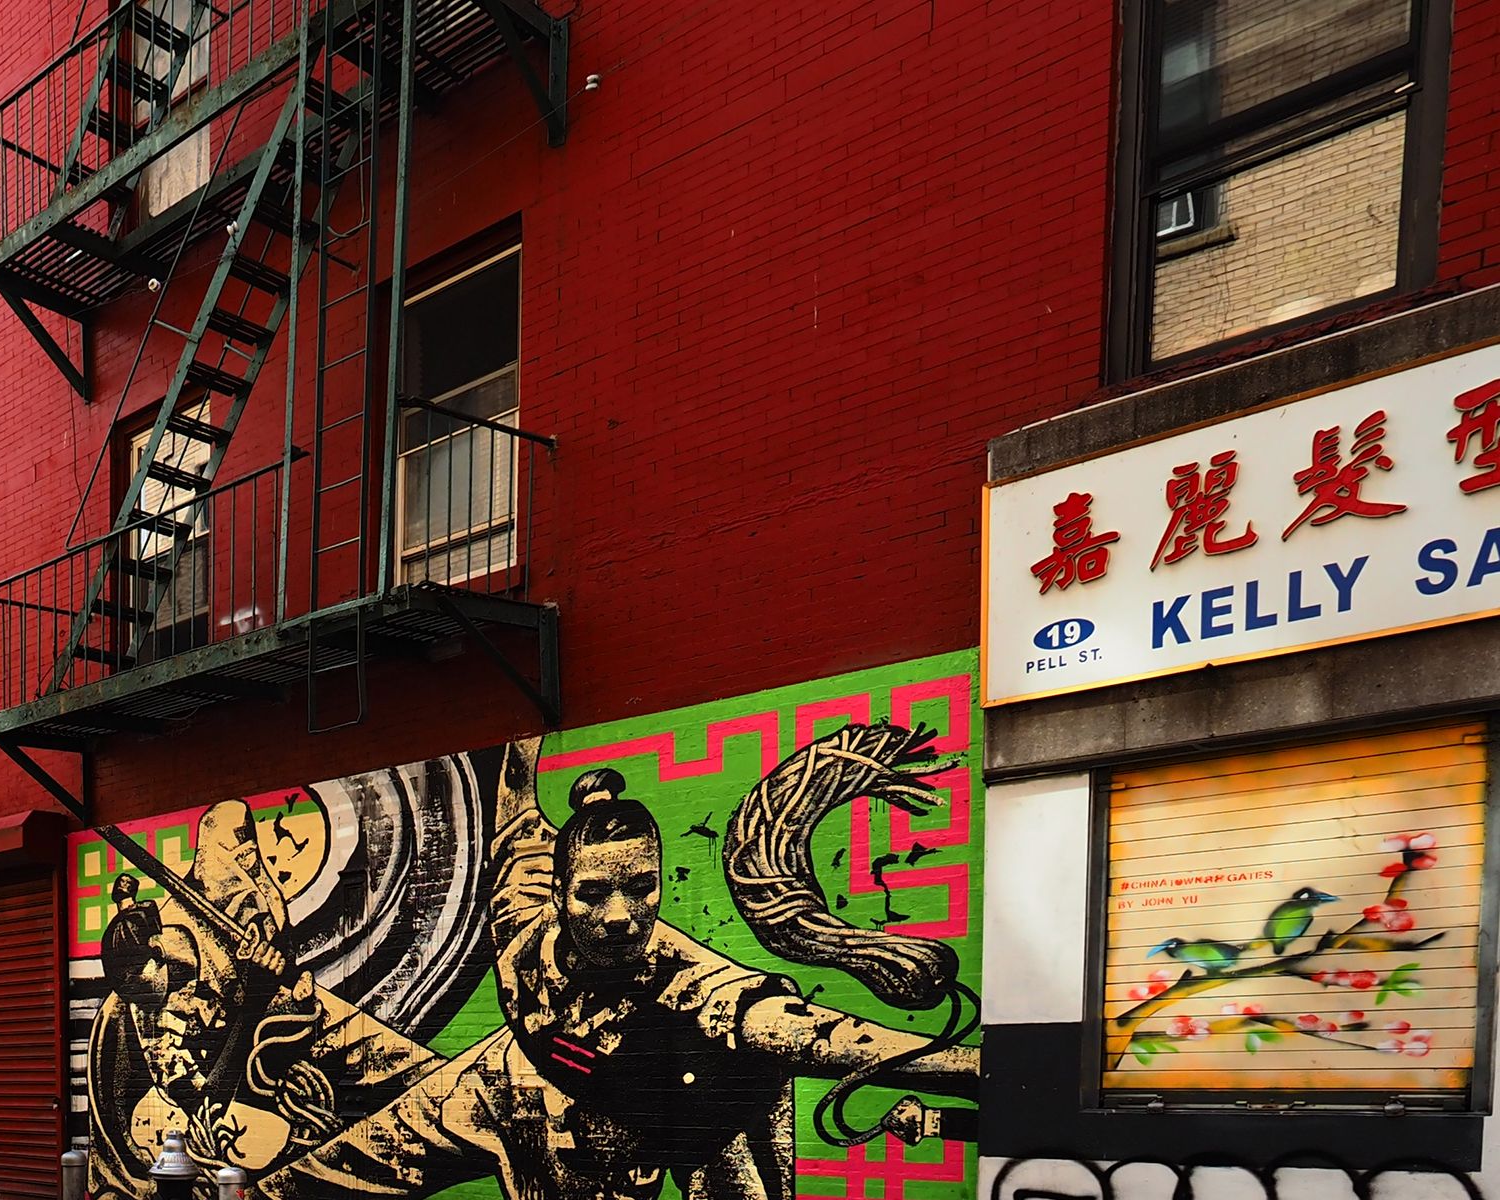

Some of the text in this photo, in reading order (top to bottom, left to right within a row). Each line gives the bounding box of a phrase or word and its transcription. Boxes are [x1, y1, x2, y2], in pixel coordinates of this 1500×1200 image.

[1151, 555, 1370, 650] KELLY
[1047, 620, 1081, 648] 19
[1026, 648, 1103, 674] PELL ST.
[1118, 895, 1198, 910] BY JOHN YU
